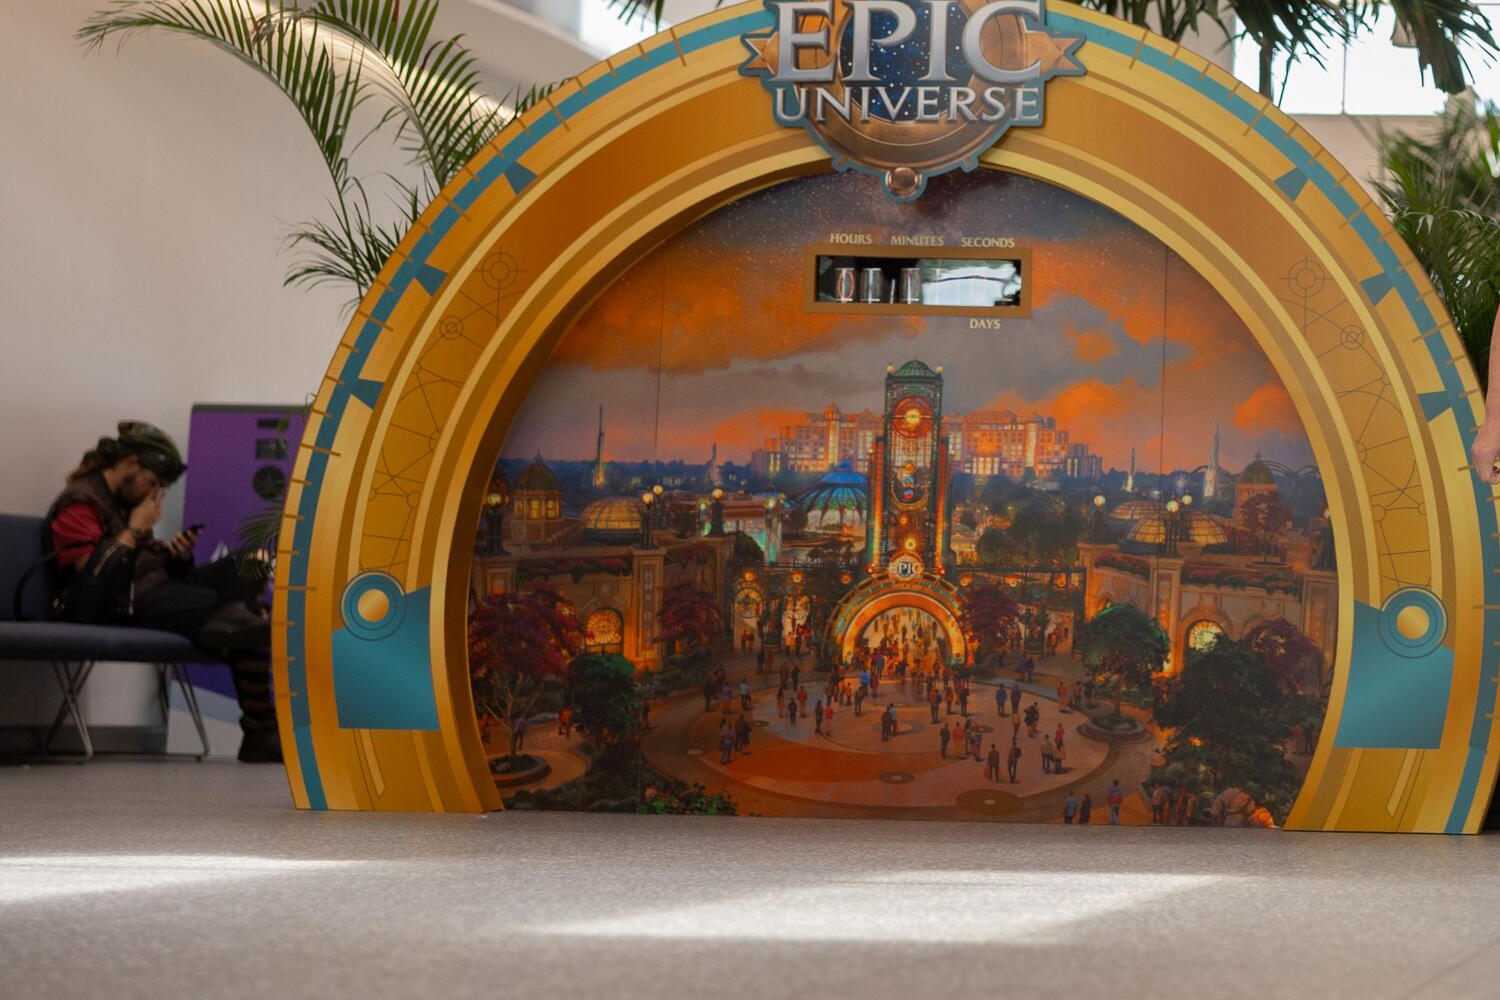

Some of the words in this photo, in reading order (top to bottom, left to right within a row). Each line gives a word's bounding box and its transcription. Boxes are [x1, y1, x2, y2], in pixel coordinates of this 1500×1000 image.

[767, 0, 1043, 83] EPIC
[775, 86, 1041, 122] UNIVERSE
[830, 233, 873, 245] HOURS
[891, 236, 945, 247] MINUTES
[961, 237, 1015, 248] SECONDS
[969, 319, 1001, 330] DAYS
